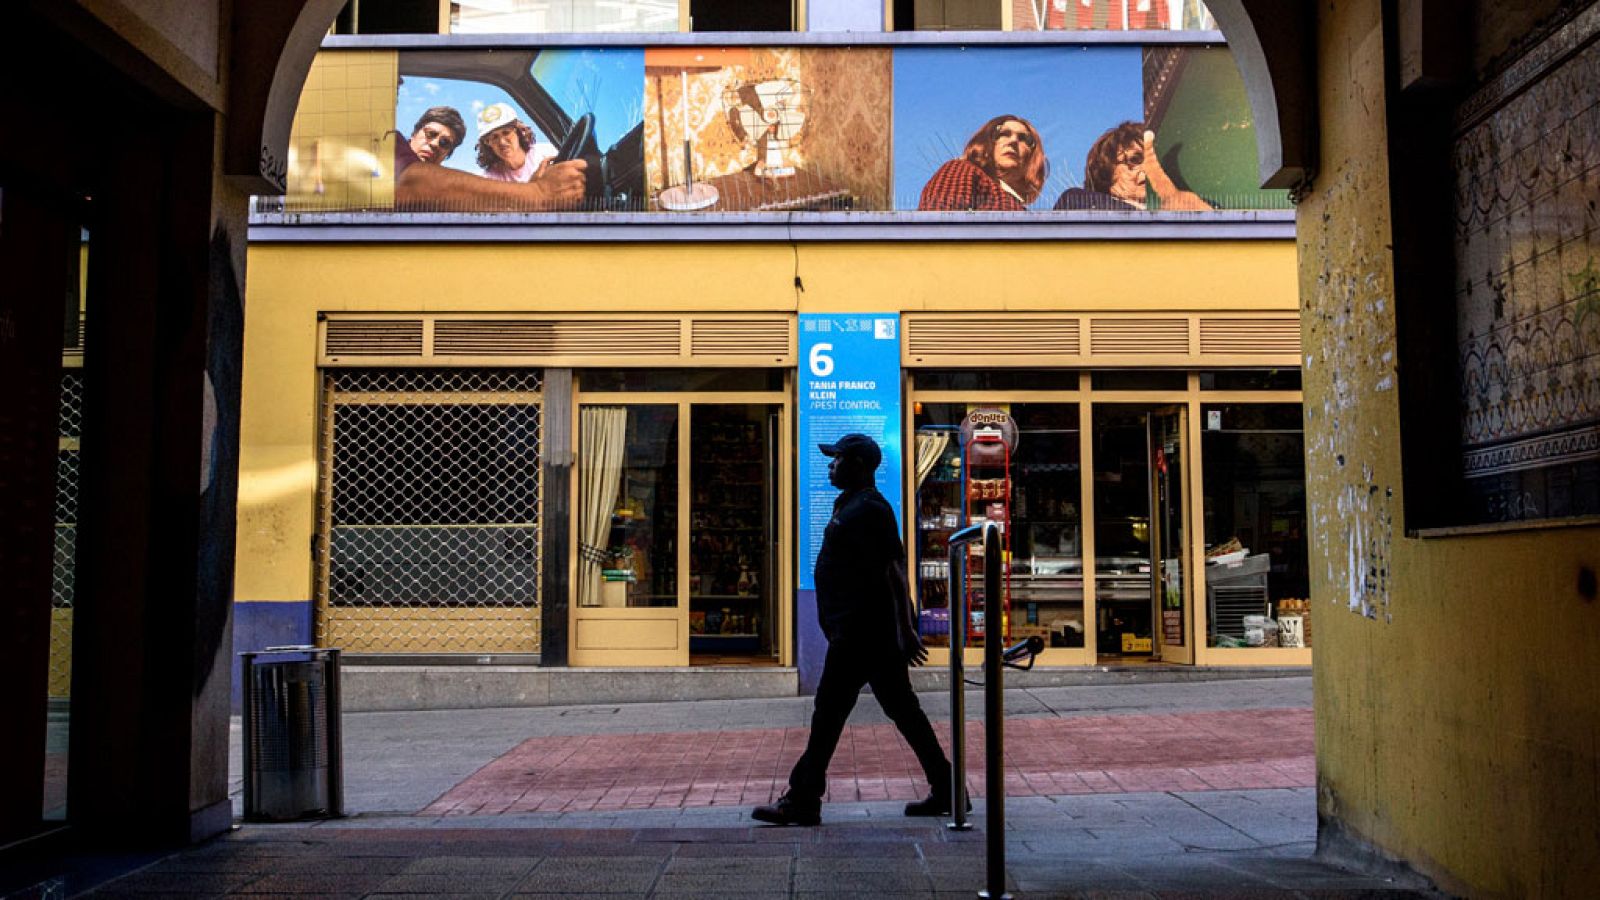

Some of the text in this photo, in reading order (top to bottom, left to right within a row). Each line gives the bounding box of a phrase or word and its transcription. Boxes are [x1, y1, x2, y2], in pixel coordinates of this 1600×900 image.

[809, 343, 834, 377] 6
[809, 381, 876, 390] TANIA FRANCO
[809, 391, 836, 399] KLEIN
[810, 401, 882, 410] /PEST CONTROL
[971, 413, 1007, 423] donuts
